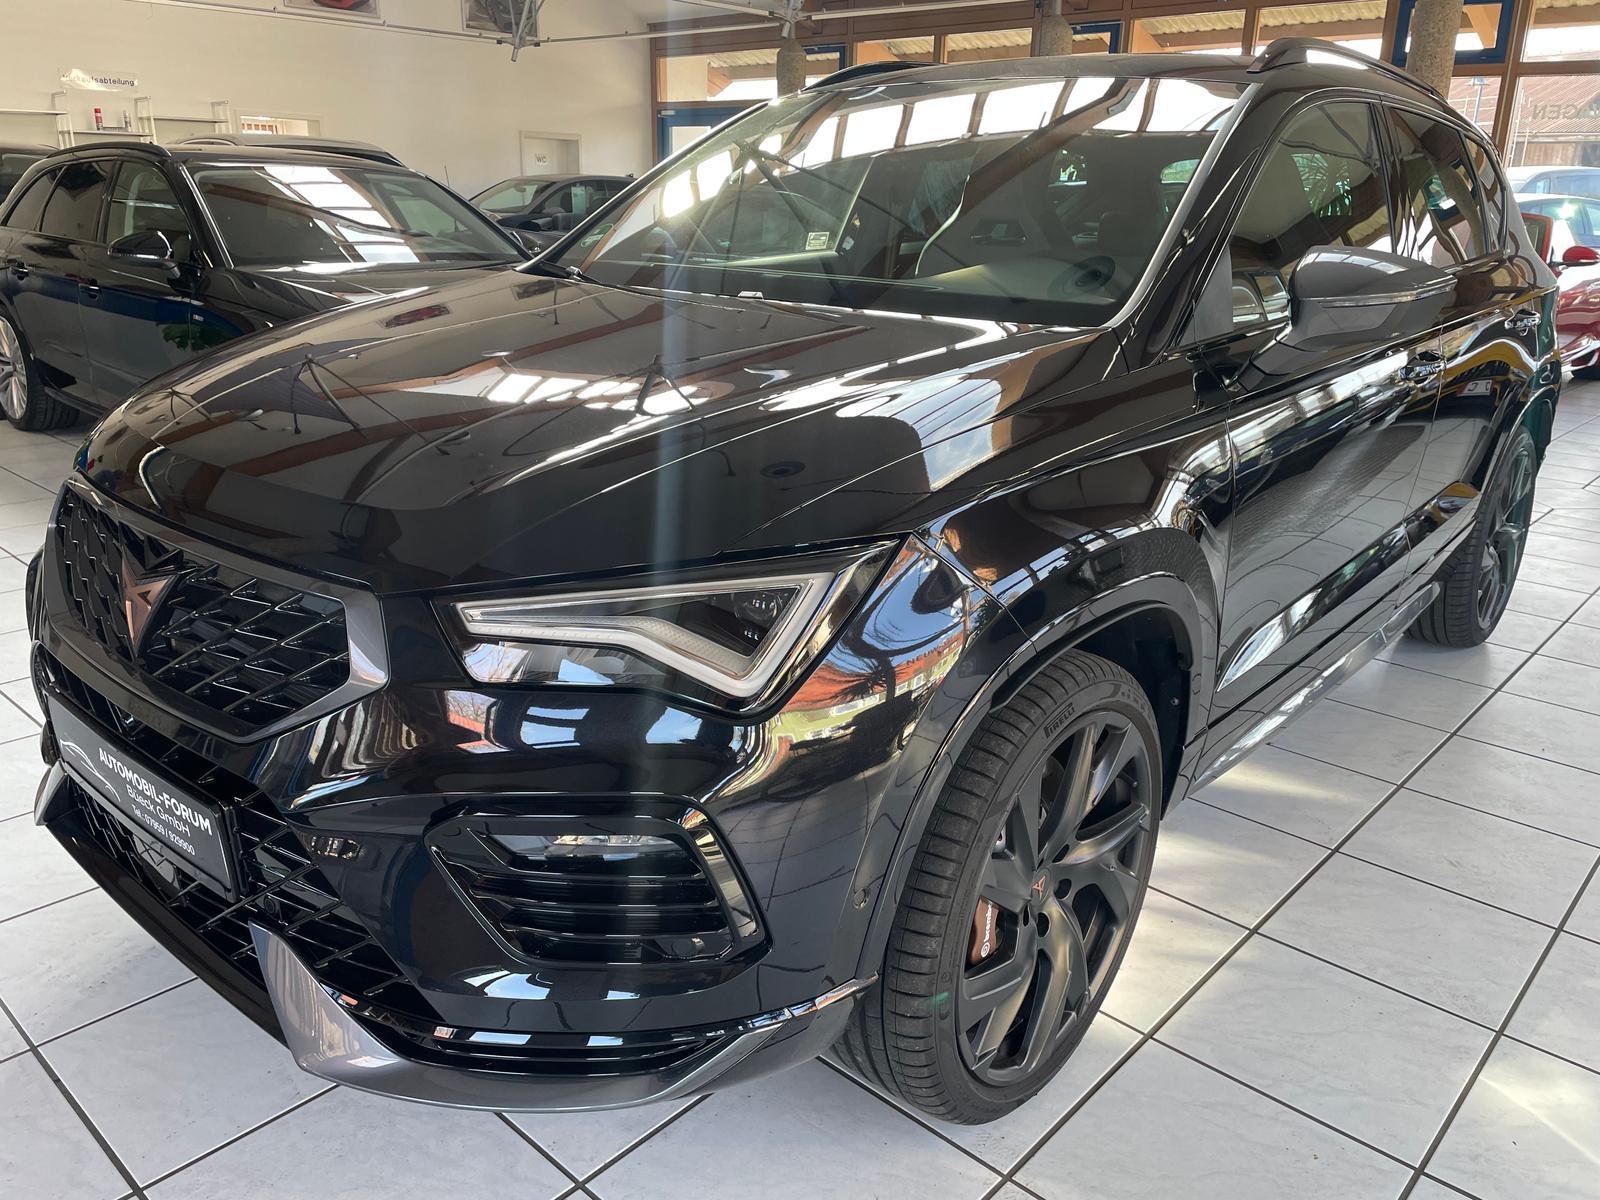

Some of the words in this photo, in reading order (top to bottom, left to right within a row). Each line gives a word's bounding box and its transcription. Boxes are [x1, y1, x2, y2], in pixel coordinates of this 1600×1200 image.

[535, 153, 547, 163] WC
[1043, 702, 1075, 739] PIRELLI
[98, 747, 213, 836] AUTOMOBIL-FORUM
[156, 805, 191, 837] GmbH
